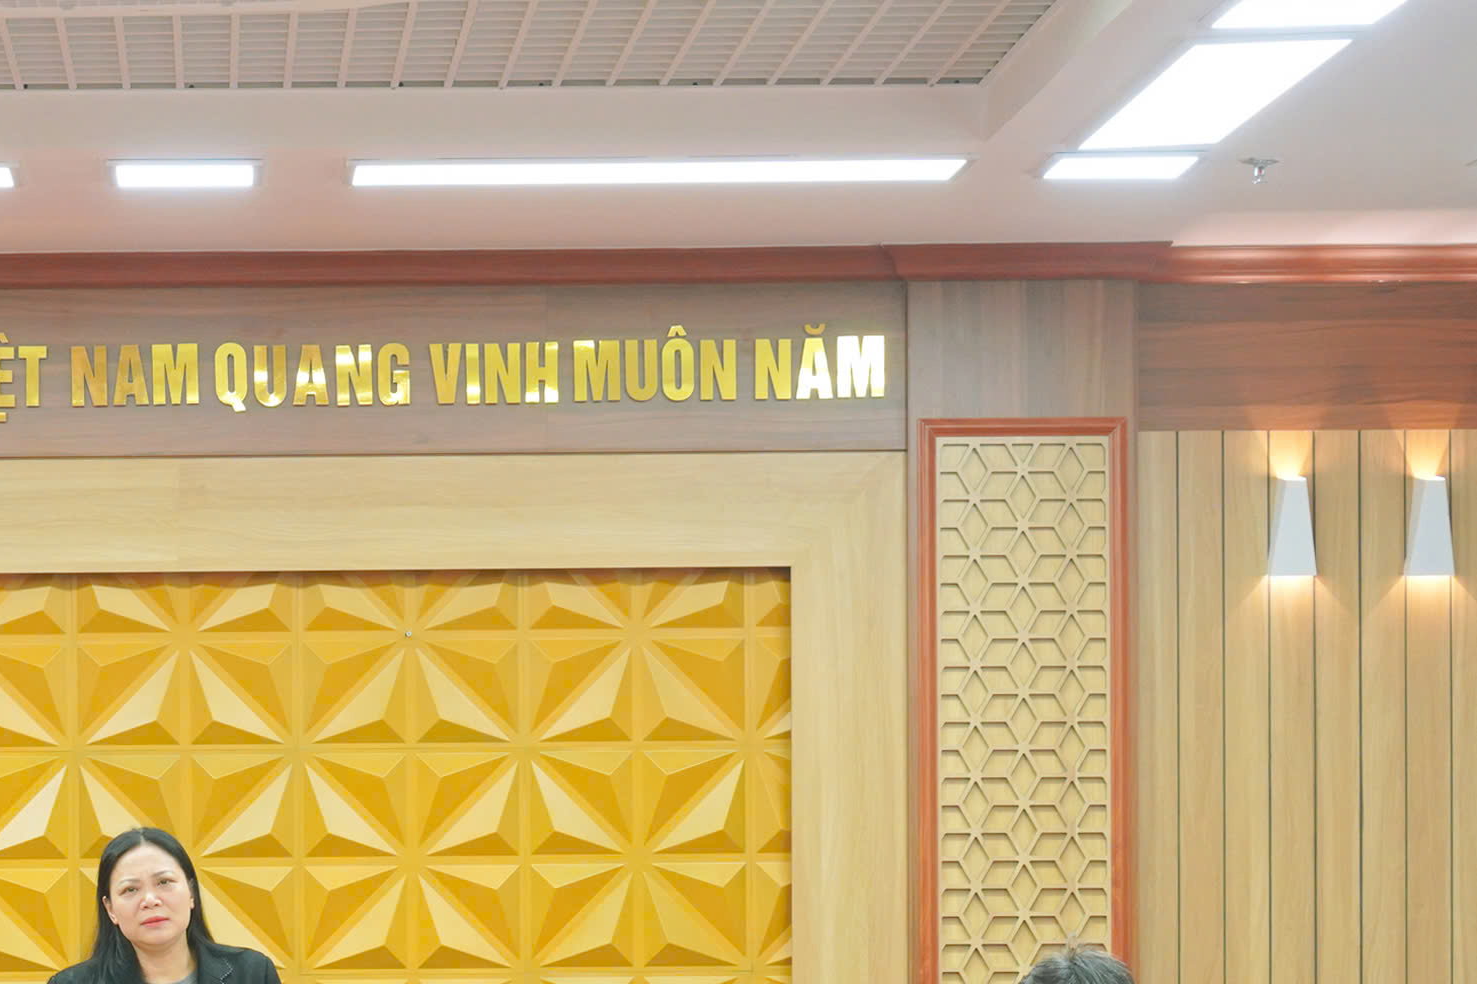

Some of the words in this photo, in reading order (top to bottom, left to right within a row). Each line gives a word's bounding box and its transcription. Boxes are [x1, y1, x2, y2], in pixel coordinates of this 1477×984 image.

[69, 343, 200, 408] NAM
[213, 341, 412, 412] QUANG
[428, 340, 564, 406] VINH
[571, 325, 737, 402] MUÔN
[754, 322, 885, 401] NĂM
